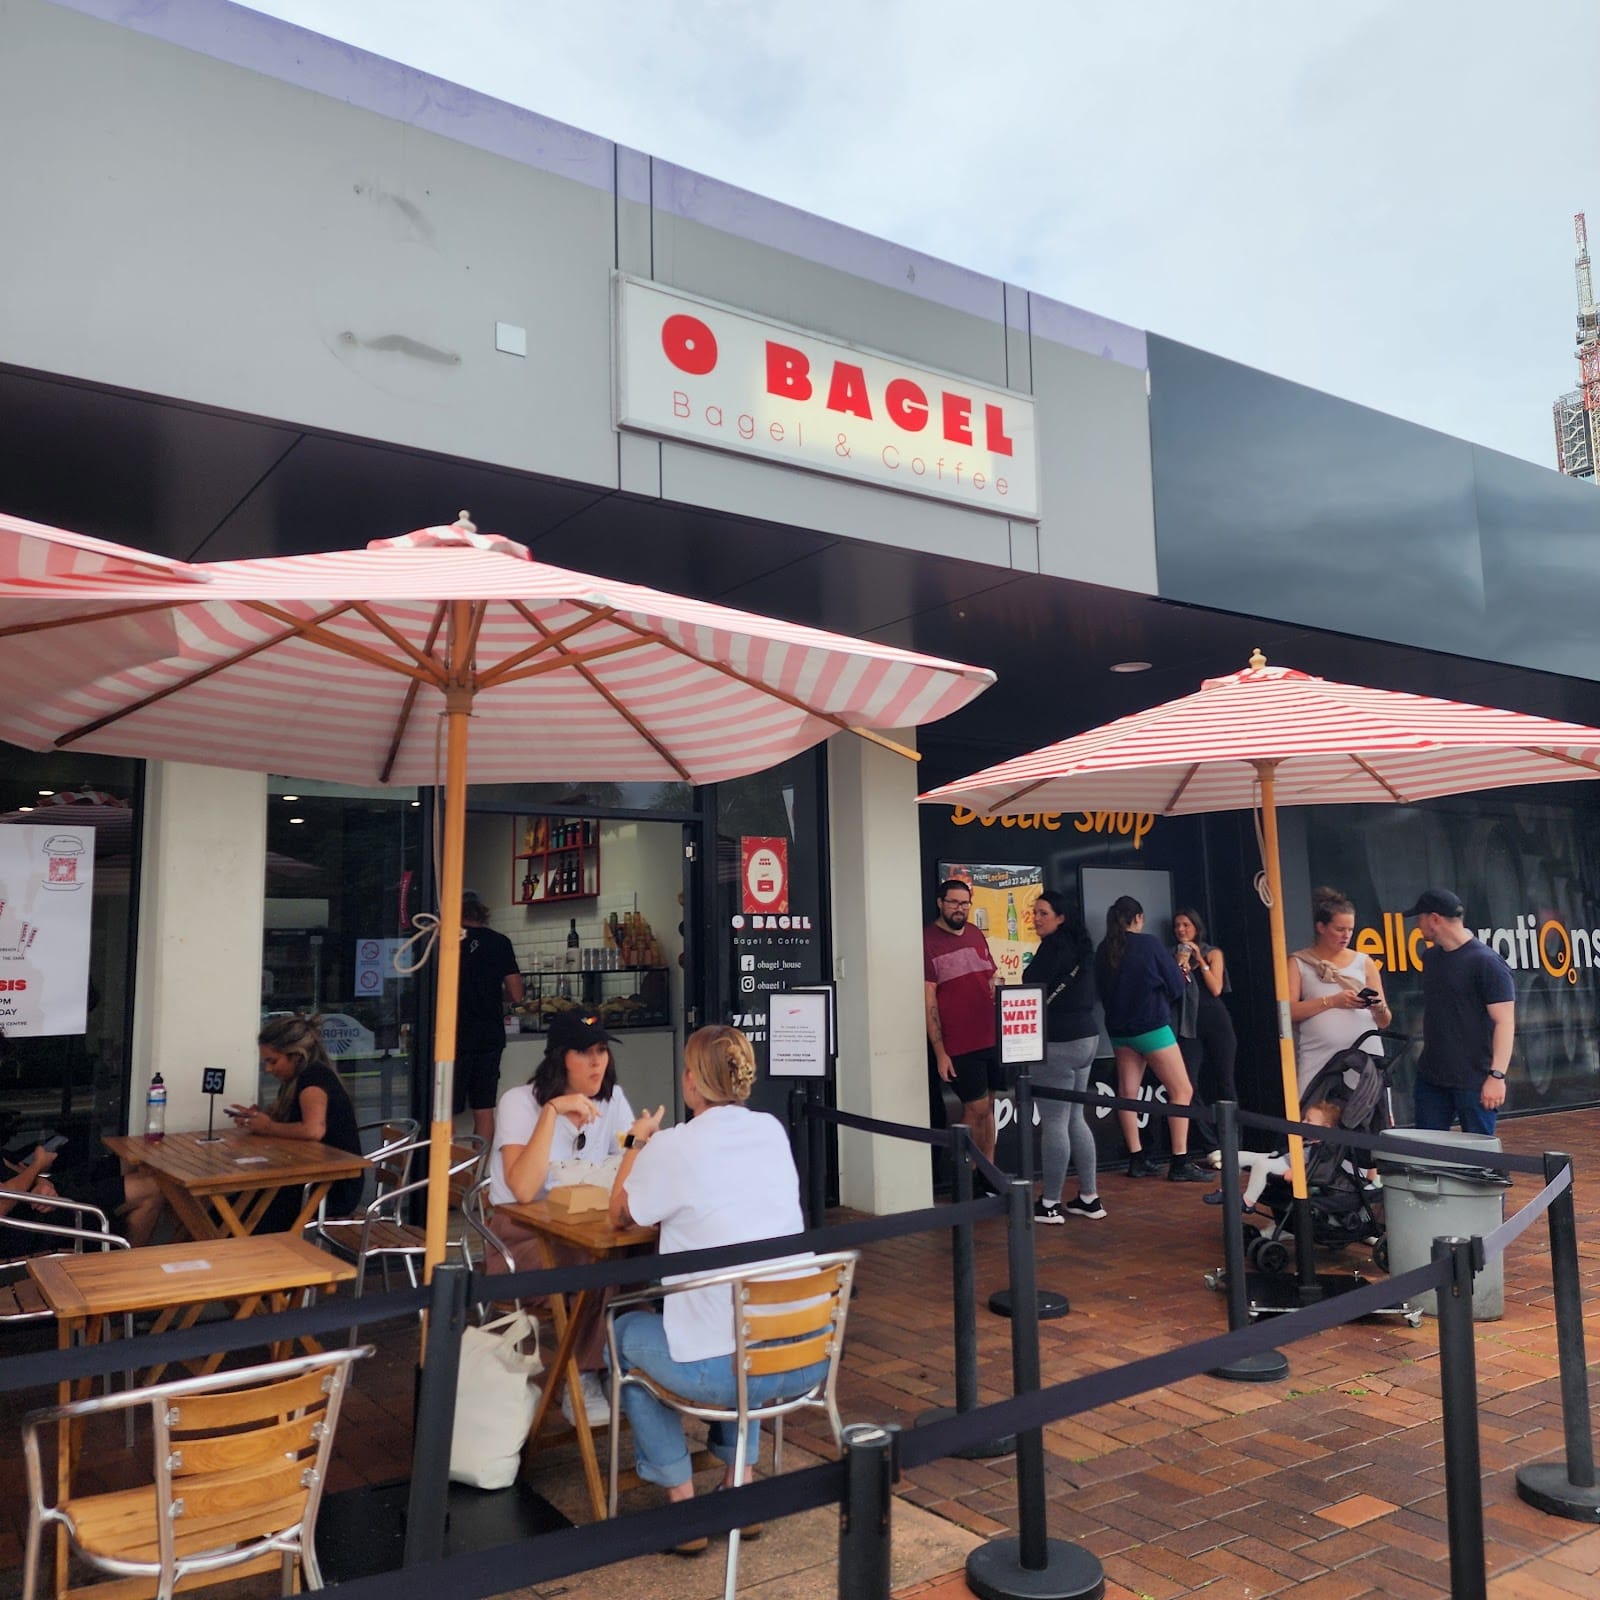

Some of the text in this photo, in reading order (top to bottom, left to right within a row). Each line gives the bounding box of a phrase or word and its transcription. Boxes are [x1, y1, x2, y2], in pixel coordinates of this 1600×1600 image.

[661, 313, 1013, 457] O BAGEL
[672, 390, 1010, 496] Bagel & Coffee
[731, 915, 812, 930] O BAGEL
[733, 937, 811, 946] Bagel & Coffee
[1000, 954, 1020, 969] $40
[1002, 998, 1038, 1008] PLEASE
[732, 1013, 766, 1027] 7AM
[1003, 1010, 1037, 1021] WAIT
[1002, 1023, 1037, 1036] HERE
[204, 1071, 223, 1090] 55
